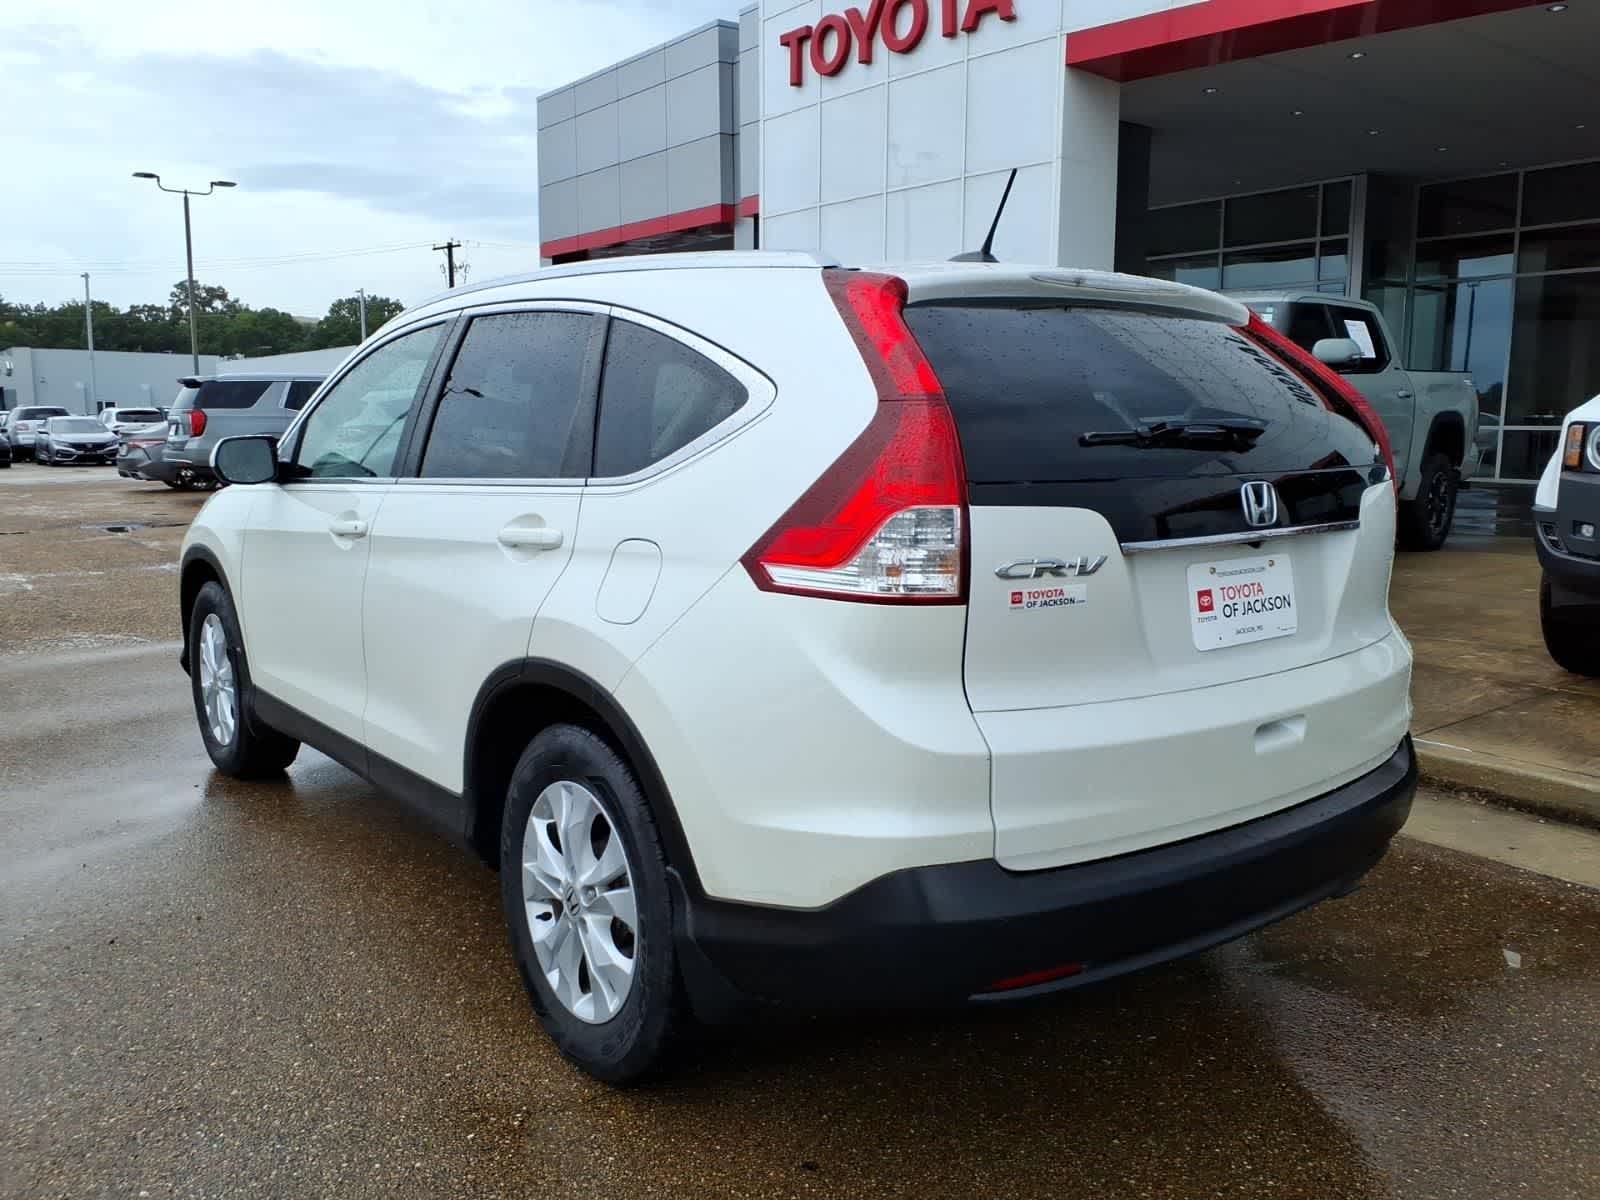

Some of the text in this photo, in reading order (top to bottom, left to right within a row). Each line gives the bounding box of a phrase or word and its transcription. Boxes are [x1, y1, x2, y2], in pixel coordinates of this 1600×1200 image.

[994, 555, 1108, 580] CR-V
[1026, 588, 1065, 600] TOYOTA
[1220, 581, 1265, 601] TOYOTA
[1026, 600, 1038, 609] OF
[1222, 594, 1292, 618] OF JACKSON
